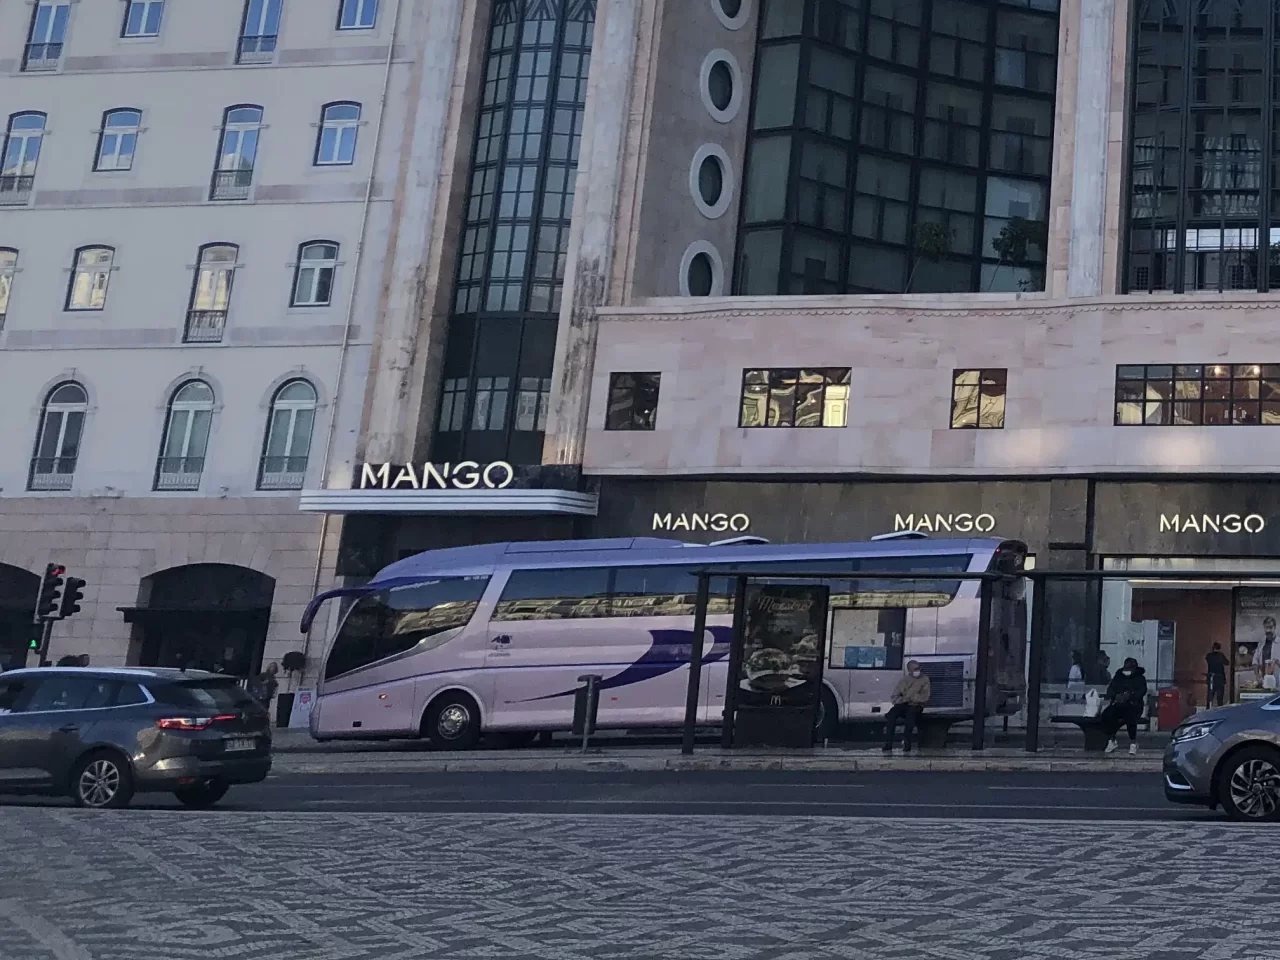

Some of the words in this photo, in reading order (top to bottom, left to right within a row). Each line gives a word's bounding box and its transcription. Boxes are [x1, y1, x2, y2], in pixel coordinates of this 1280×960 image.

[360, 460, 514, 489] MANGO
[652, 512, 750, 532] MANGO
[893, 513, 995, 532] MANGO
[1159, 513, 1265, 533] MANGO
